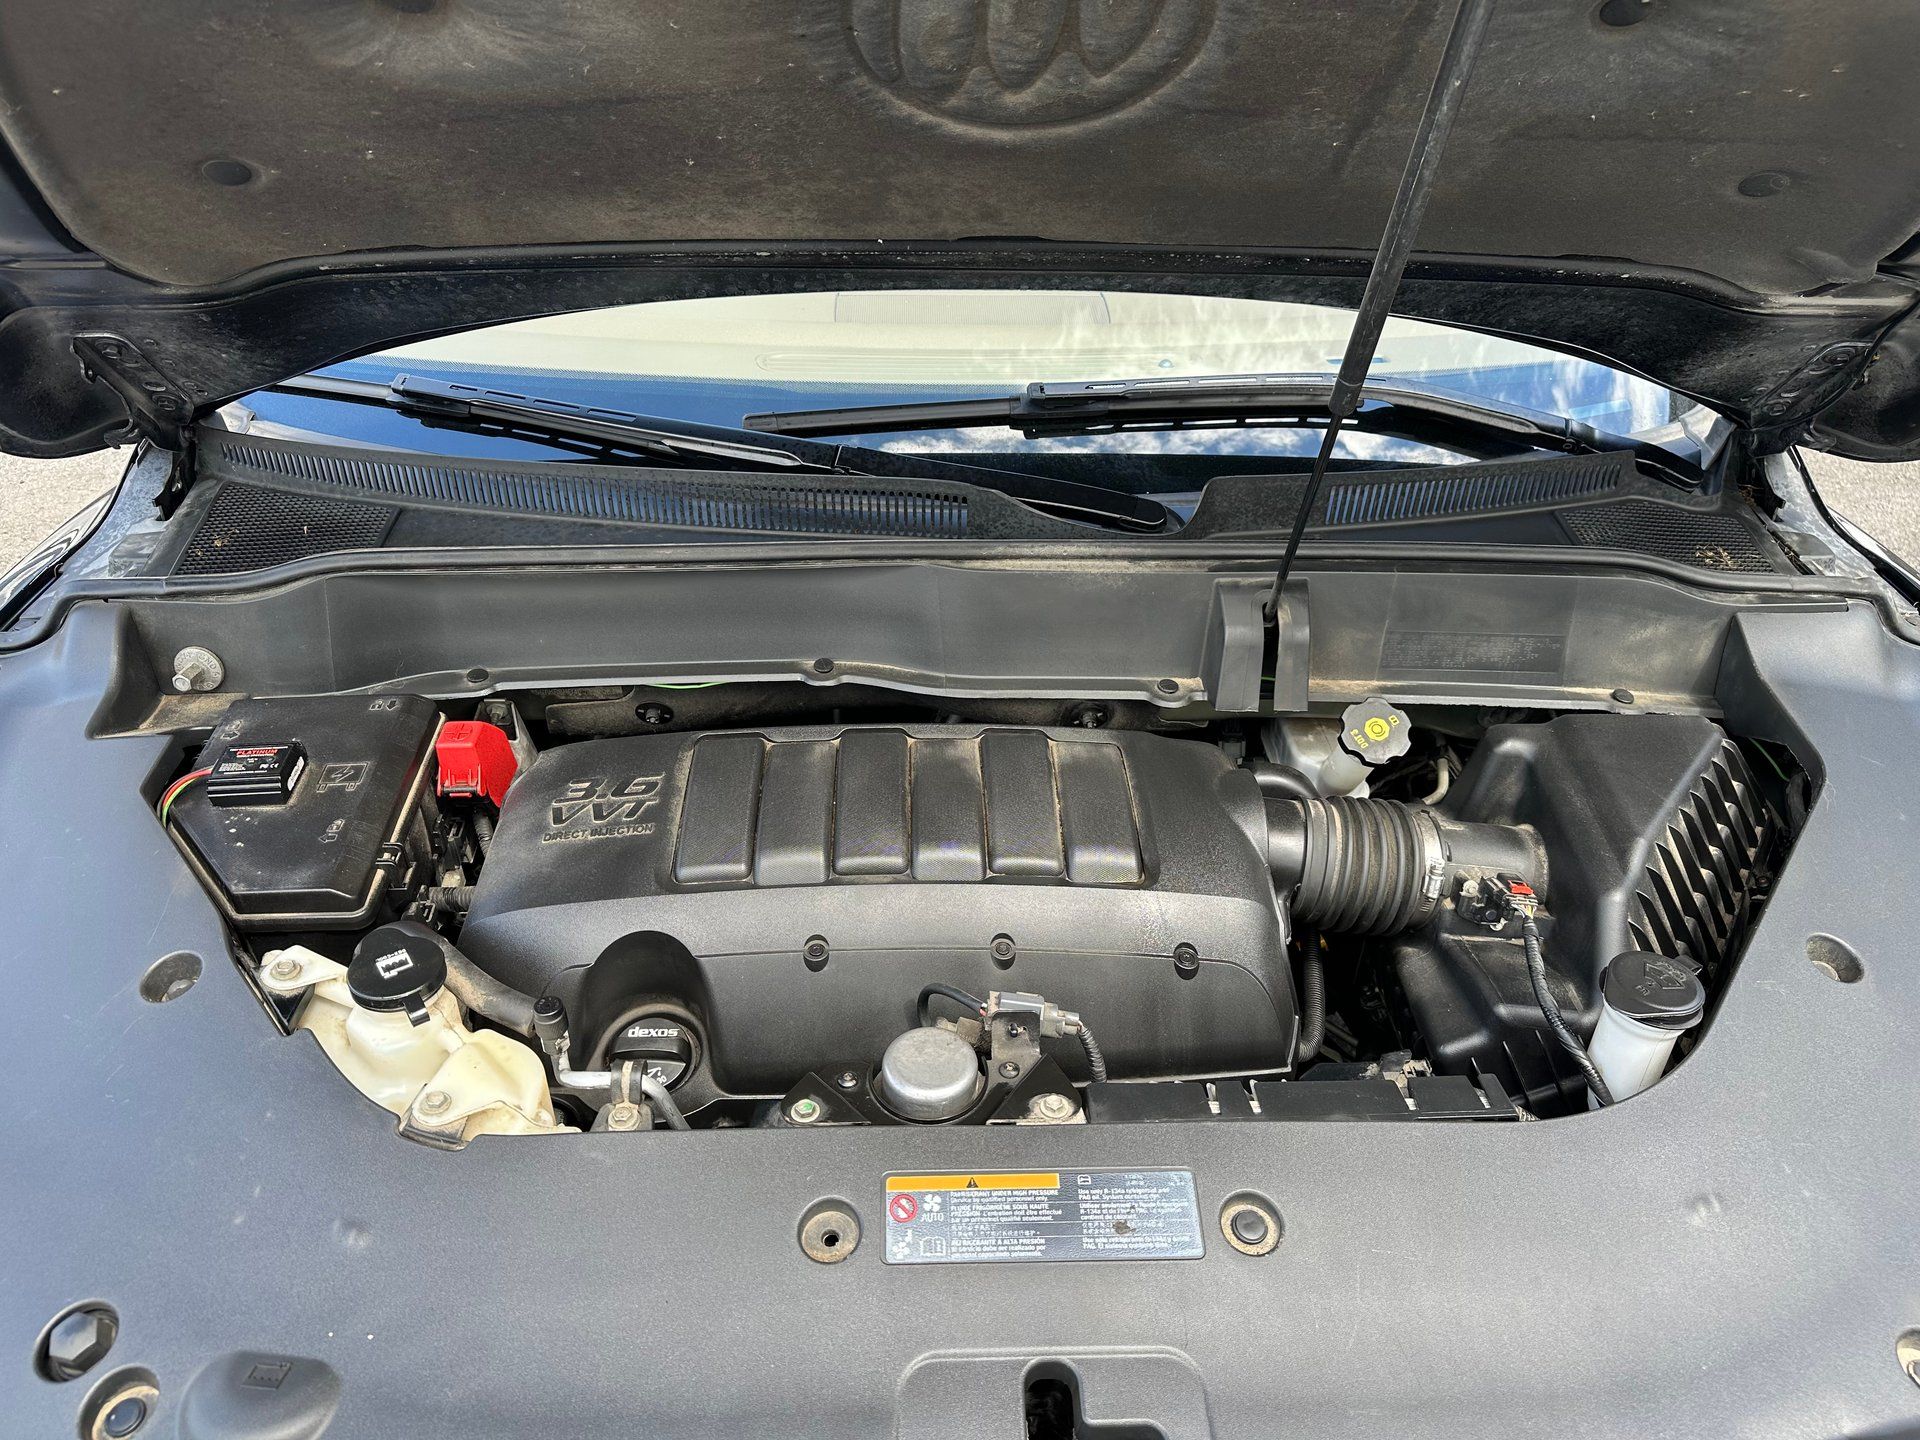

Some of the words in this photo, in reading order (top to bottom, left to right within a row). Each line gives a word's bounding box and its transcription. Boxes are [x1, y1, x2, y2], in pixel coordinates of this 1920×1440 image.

[552, 772, 666, 805] 3.6
[552, 799, 659, 827] VVT
[542, 830, 588, 843] DIRECT
[589, 823, 655, 839] INJECTION
[627, 1026, 680, 1038] dexos
[921, 1212, 944, 1221] AUTO
